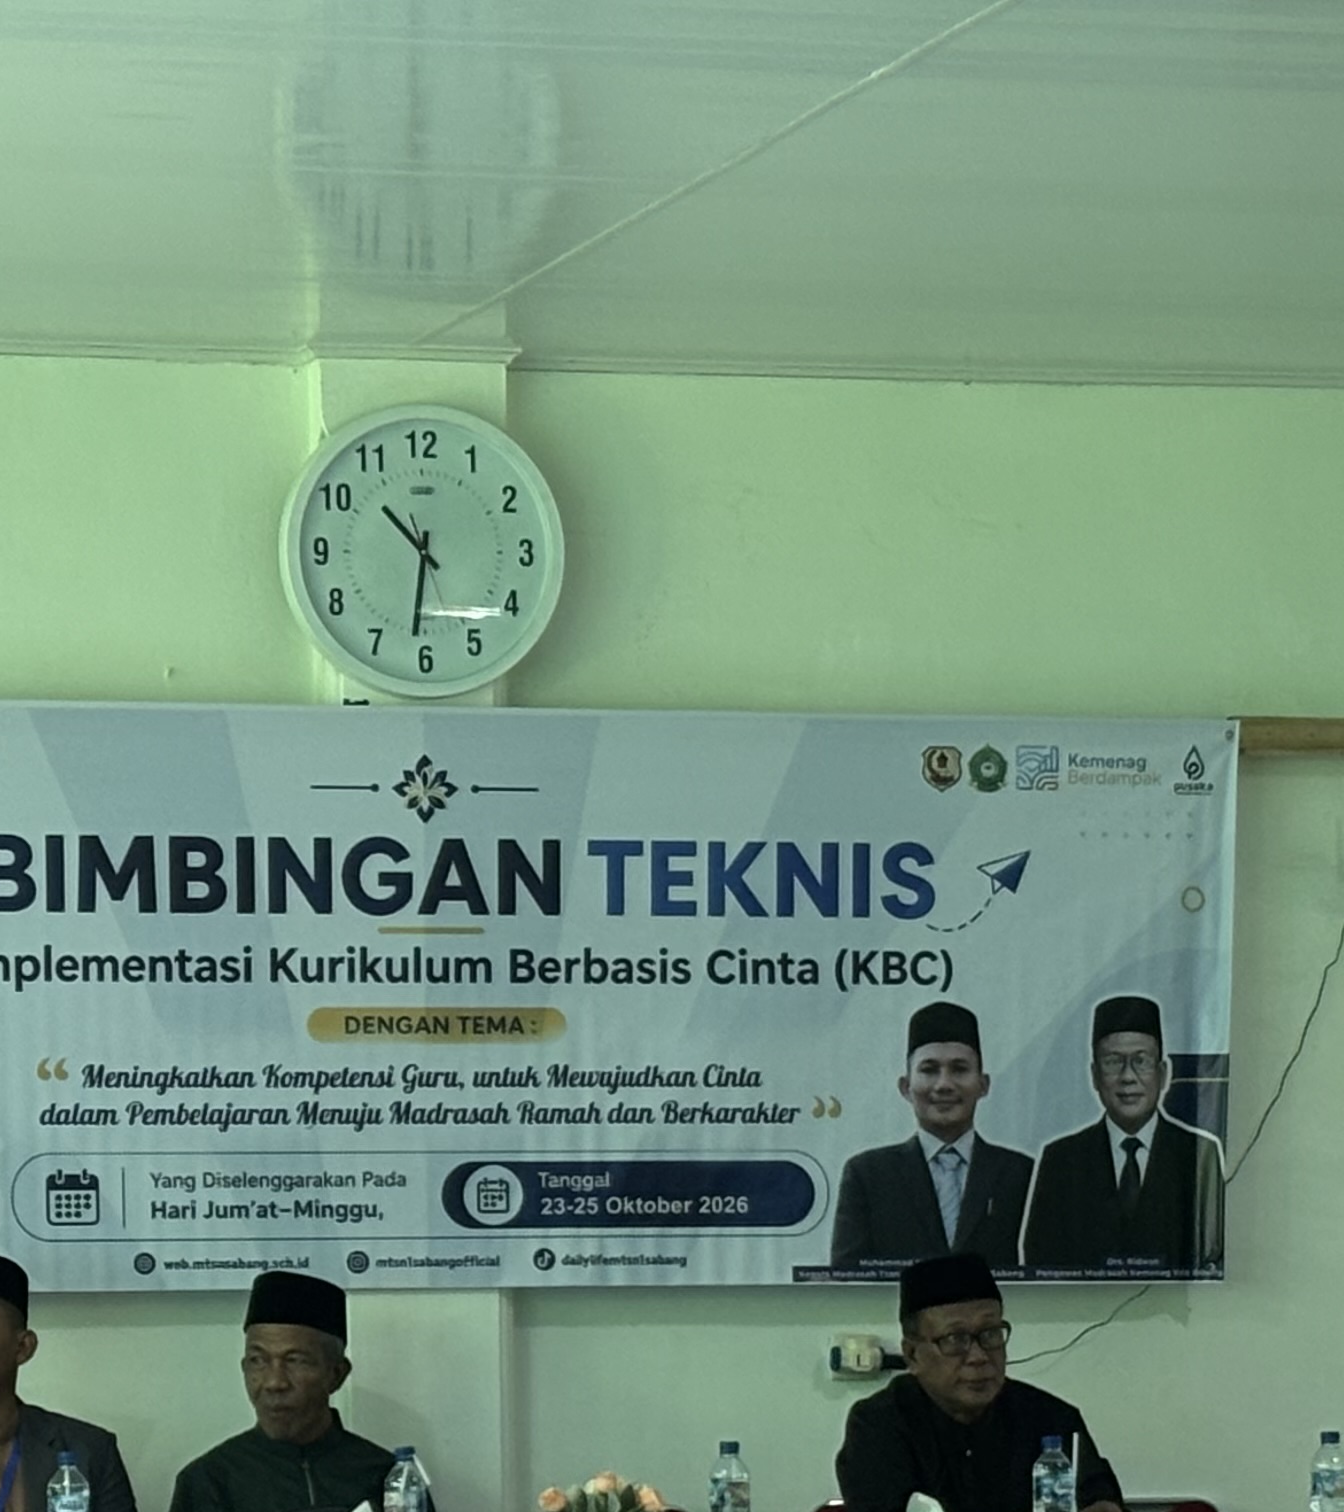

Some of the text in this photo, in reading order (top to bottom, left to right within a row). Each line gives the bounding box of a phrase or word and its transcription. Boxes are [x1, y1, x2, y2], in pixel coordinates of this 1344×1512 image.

[355, 443, 385, 473] 11
[404, 429, 439, 459] 12
[464, 444, 477, 474] 1
[319, 482, 352, 512] 10
[501, 485, 518, 514] 2
[313, 537, 329, 566] 9
[518, 538, 534, 568] 3
[328, 588, 344, 616] 8
[503, 589, 520, 617] 4
[367, 627, 384, 656] 7
[466, 628, 483, 657] 5
[417, 645, 434, 674] 6
[1067, 752, 1148, 772] Kemenag
[1067, 770, 1163, 787] Berdampak
[587, 839, 936, 920] TEKNIS
[269, 945, 493, 984] Kurikulum
[509, 946, 692, 985] Berbasis
[702, 1063, 763, 1088] Cinta
[834, 948, 954, 993] (KBC)
[344, 1015, 451, 1035] DENGAN
[455, 1015, 525, 1035] TEMA
[81, 1063, 763, 1095] Meningkatkan Kompetensi Guru, untuk Mewujudkan Cinta
[38, 1099, 801, 1131] dalam Pembelajaran Menuju Madrasah Ramah dan Berkarakter
[149, 1170, 407, 1194] Yang Diselenggarakan Pada
[537, 1170, 611, 1193] Tanggal
[150, 1199, 197, 1220] Hari
[540, 1195, 749, 1216] 23-25 Oktober 2026
